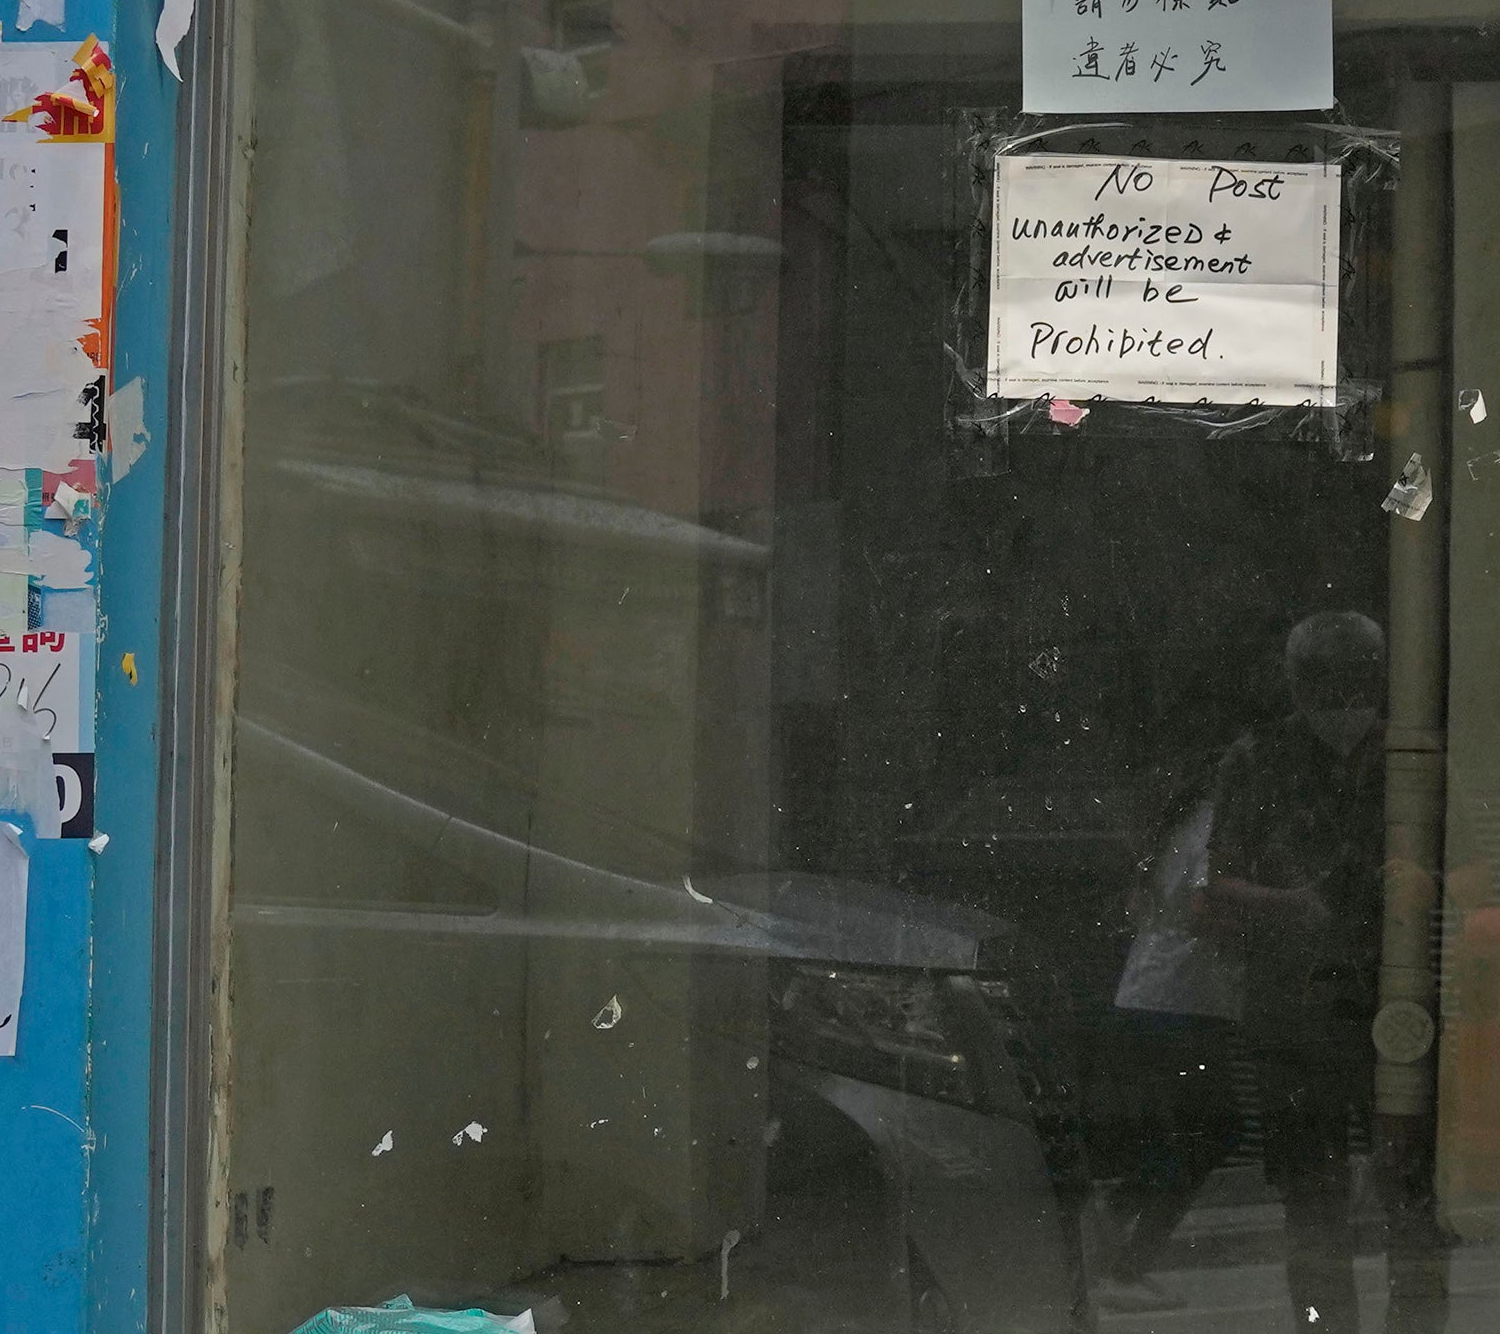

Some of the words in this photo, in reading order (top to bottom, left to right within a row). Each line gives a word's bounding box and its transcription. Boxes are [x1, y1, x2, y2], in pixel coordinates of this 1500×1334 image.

[1071, 35, 1228, 87] 違者必究
[1094, 162, 1154, 202] No
[1207, 164, 1285, 204] Post
[1051, 248, 1253, 275] advertisement
[1054, 281, 1112, 303] will
[1142, 279, 1200, 306] be
